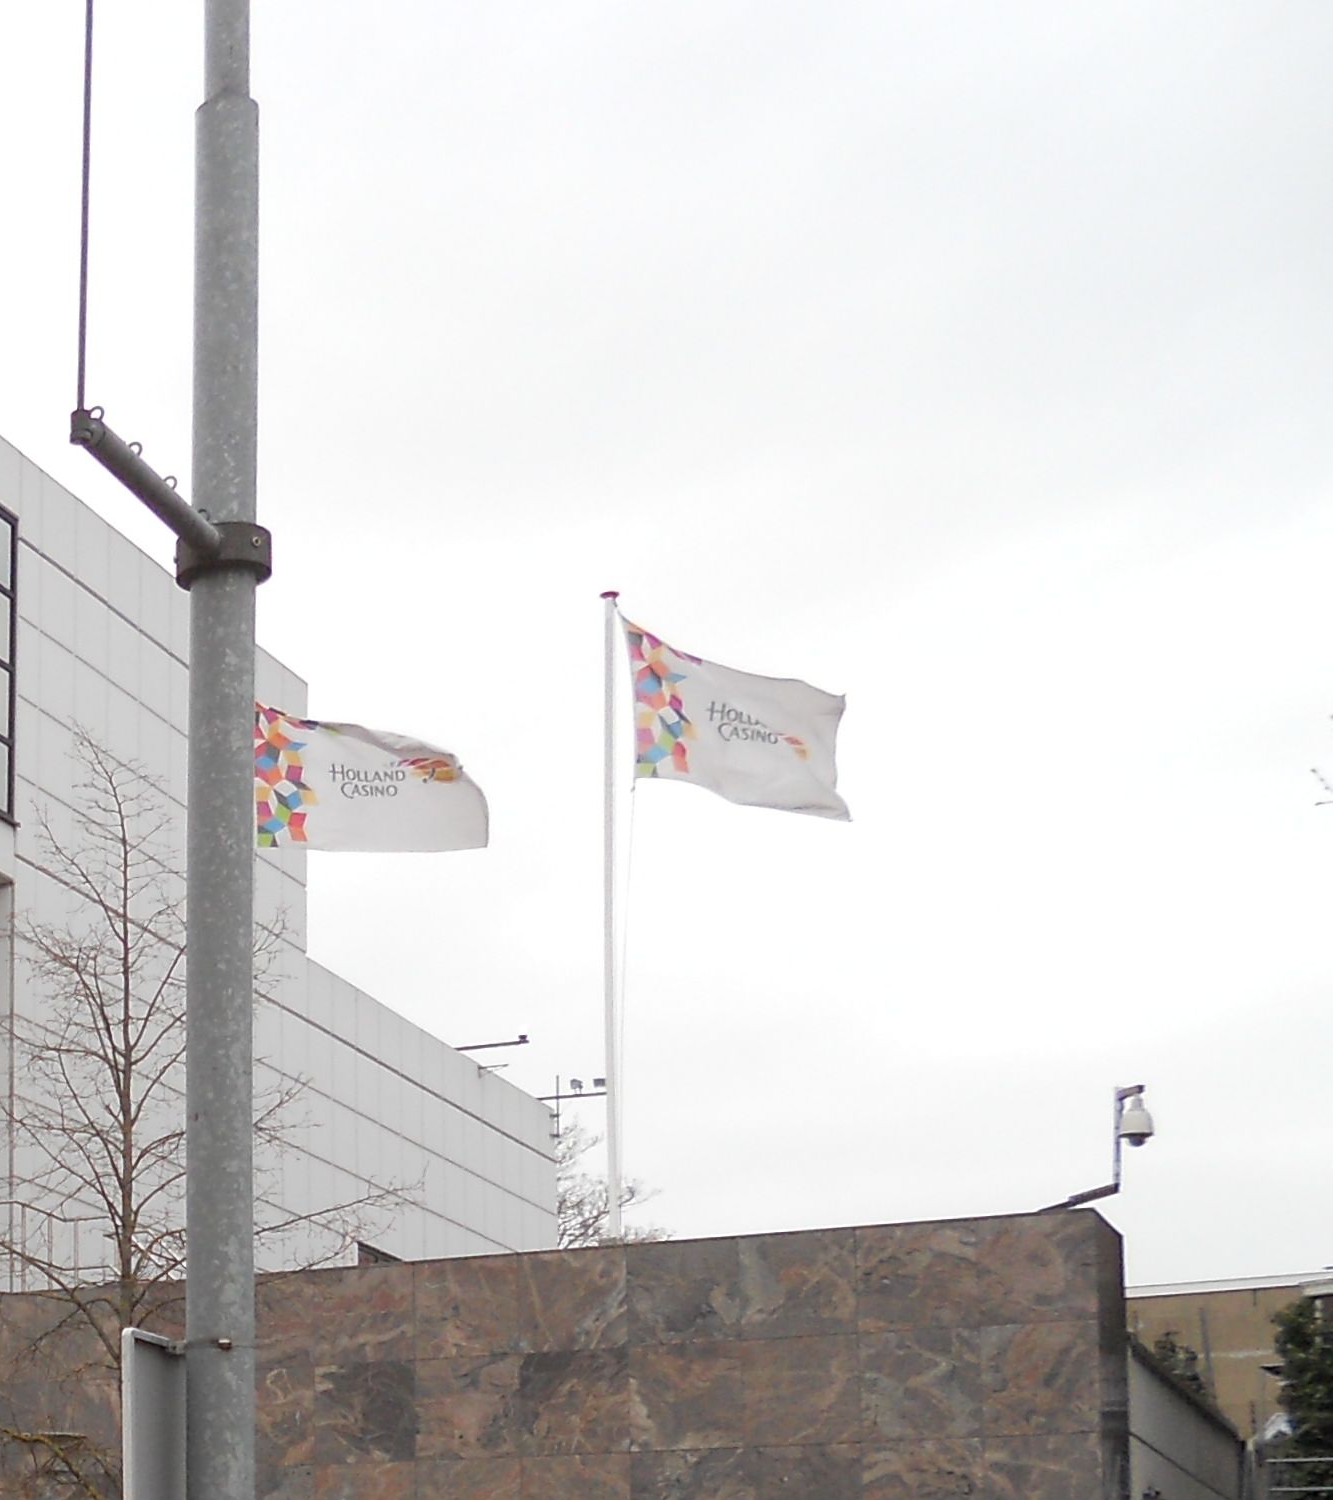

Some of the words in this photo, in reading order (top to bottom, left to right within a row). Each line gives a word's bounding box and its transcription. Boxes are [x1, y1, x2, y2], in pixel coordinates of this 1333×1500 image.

[706, 701, 769, 730] HOLL
[717, 722, 779, 745] CASINO
[328, 763, 406, 783] HOLLAND
[340, 782, 398, 799] CASINO
